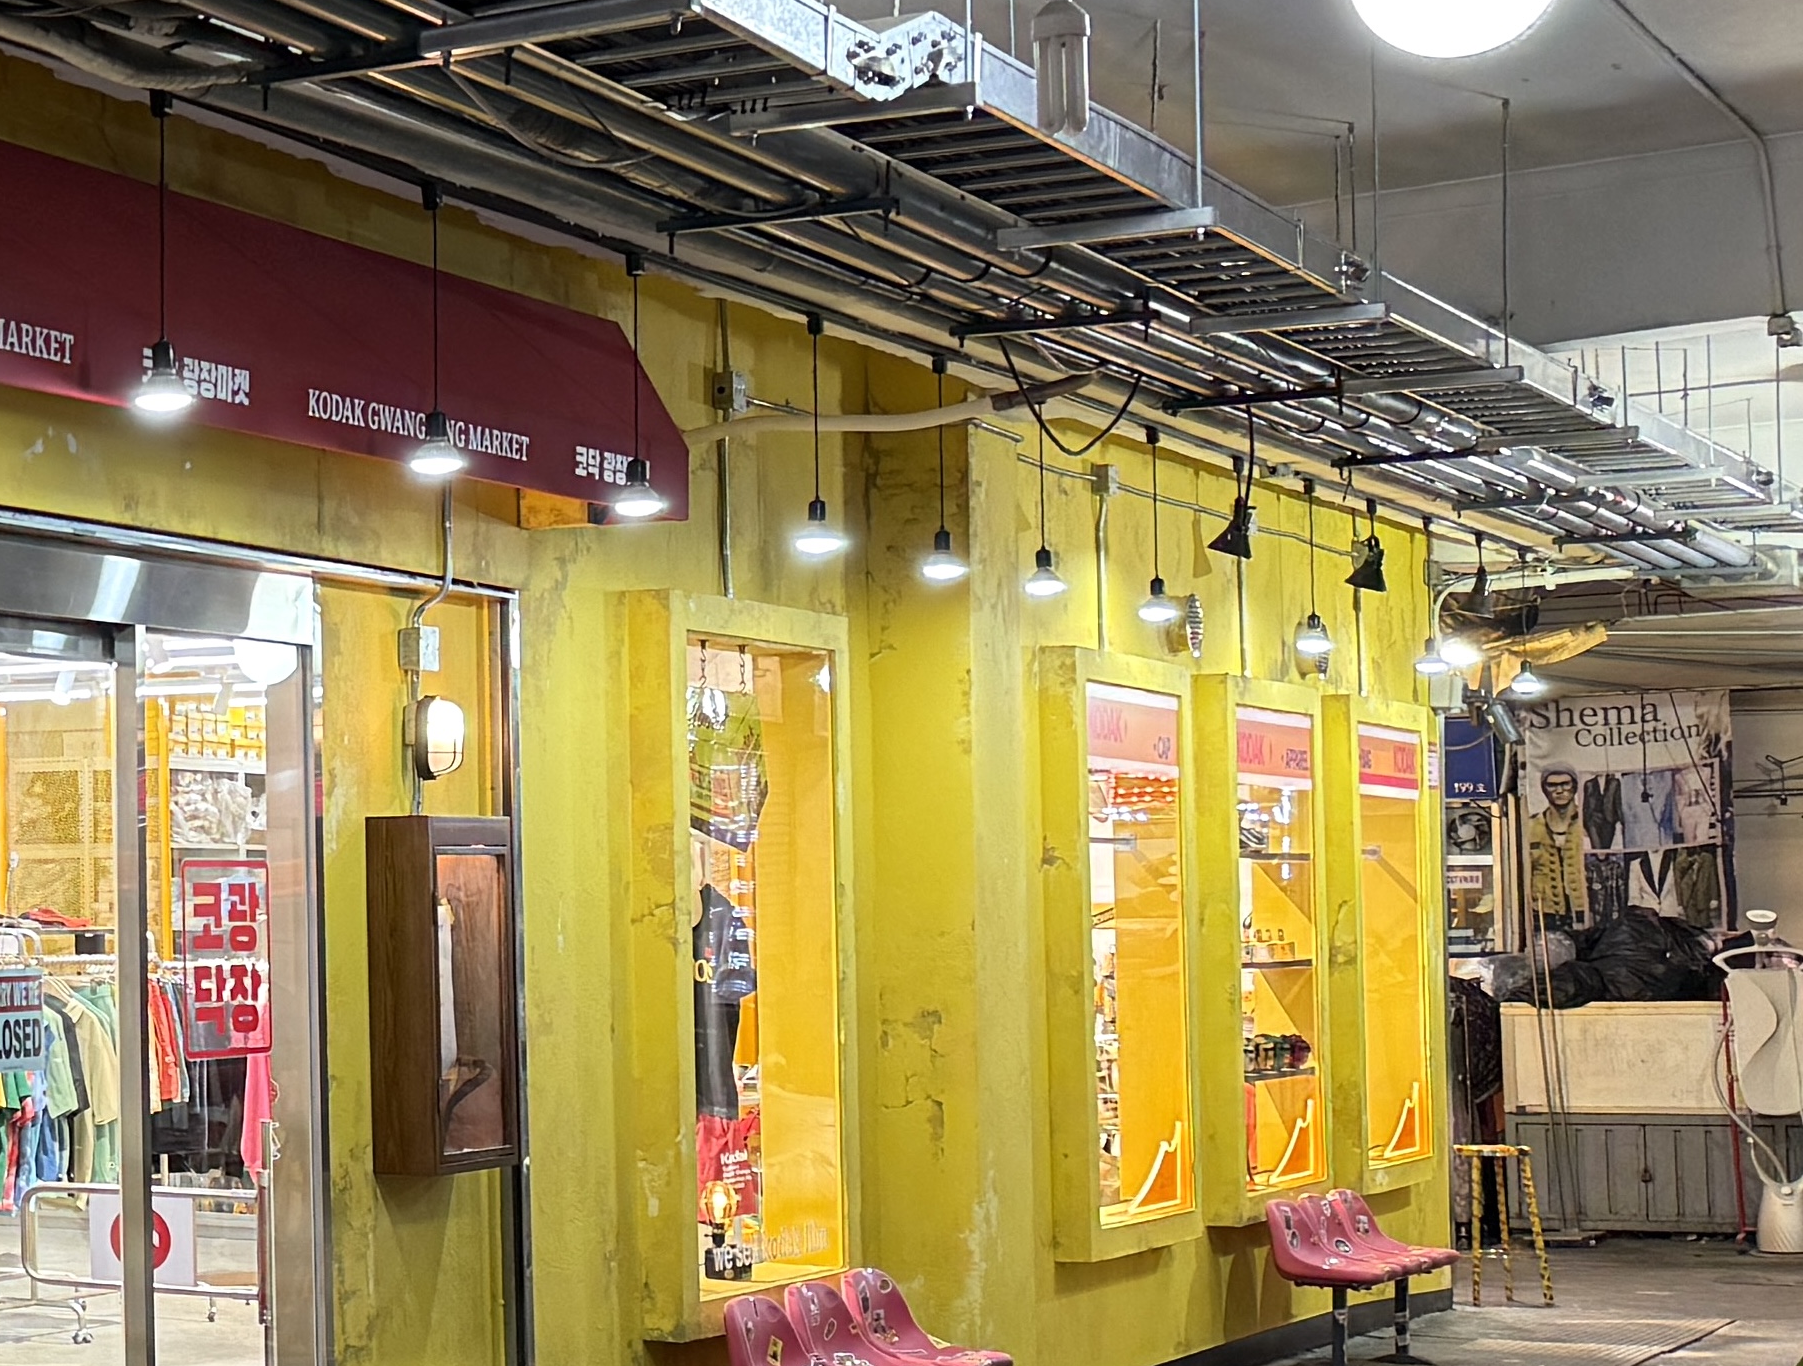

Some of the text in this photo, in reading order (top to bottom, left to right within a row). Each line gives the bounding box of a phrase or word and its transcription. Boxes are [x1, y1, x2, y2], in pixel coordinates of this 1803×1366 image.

[308, 388, 530, 462] KODAK GWANGNG MARKET
[1530, 700, 1662, 730] Shema
[1574, 721, 1703, 748] Collection
